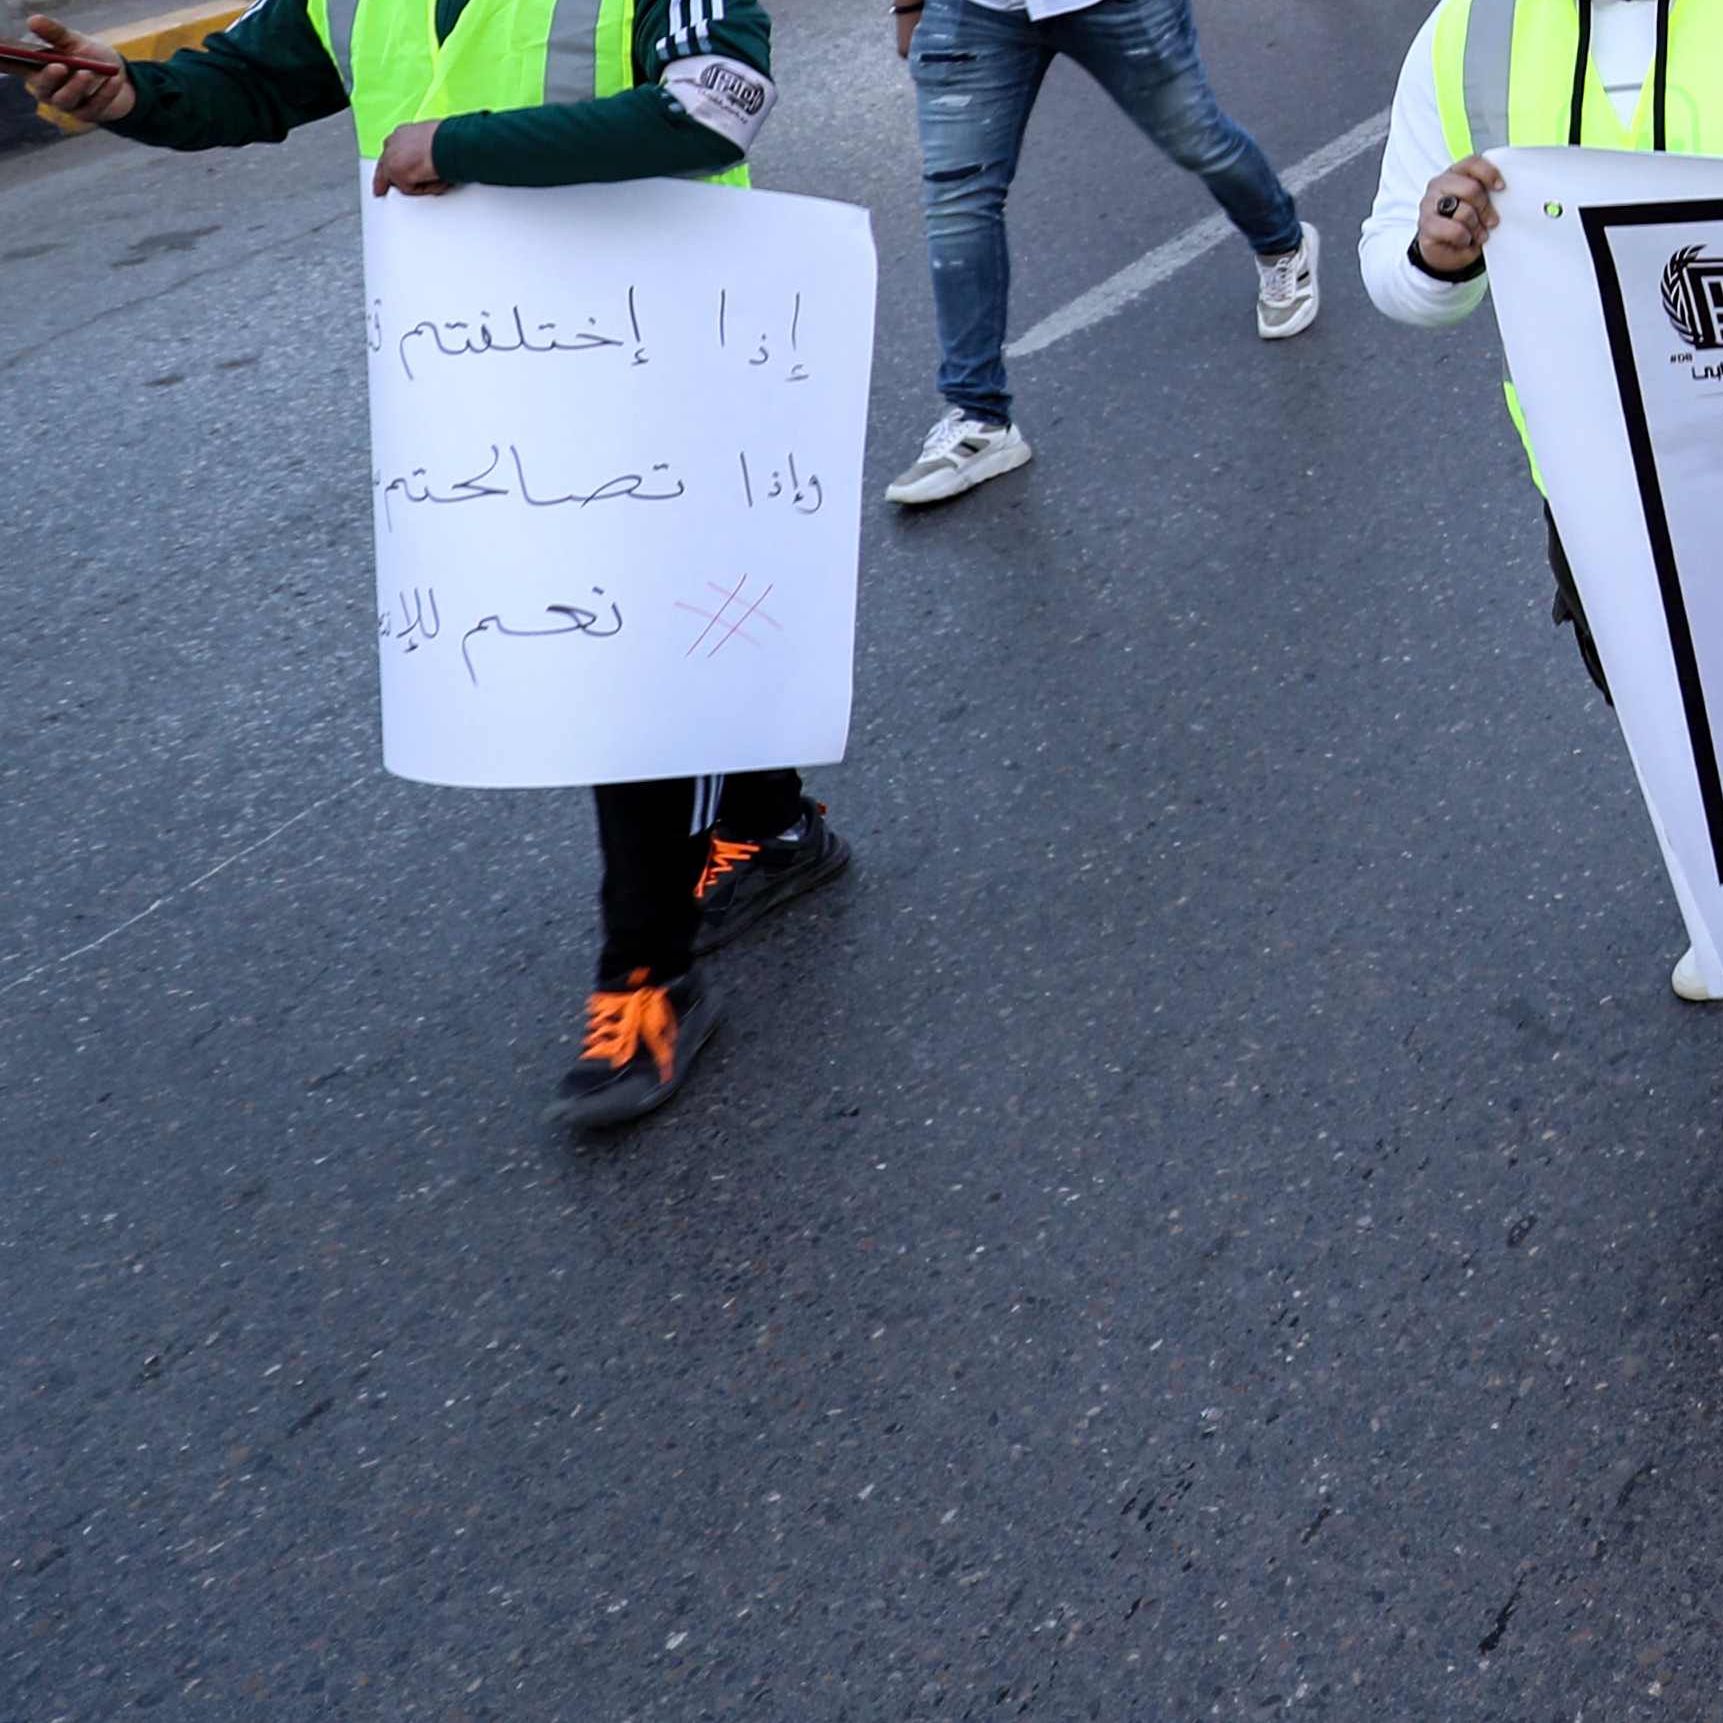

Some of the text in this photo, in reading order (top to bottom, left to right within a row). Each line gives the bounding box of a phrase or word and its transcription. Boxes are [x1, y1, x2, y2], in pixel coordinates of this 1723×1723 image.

[399, 285, 651, 382] إختلفتم
[719, 288, 810, 382] إذا
[382, 443, 823, 533] وإذا تصالحتم
[461, 584, 625, 686] نعم
